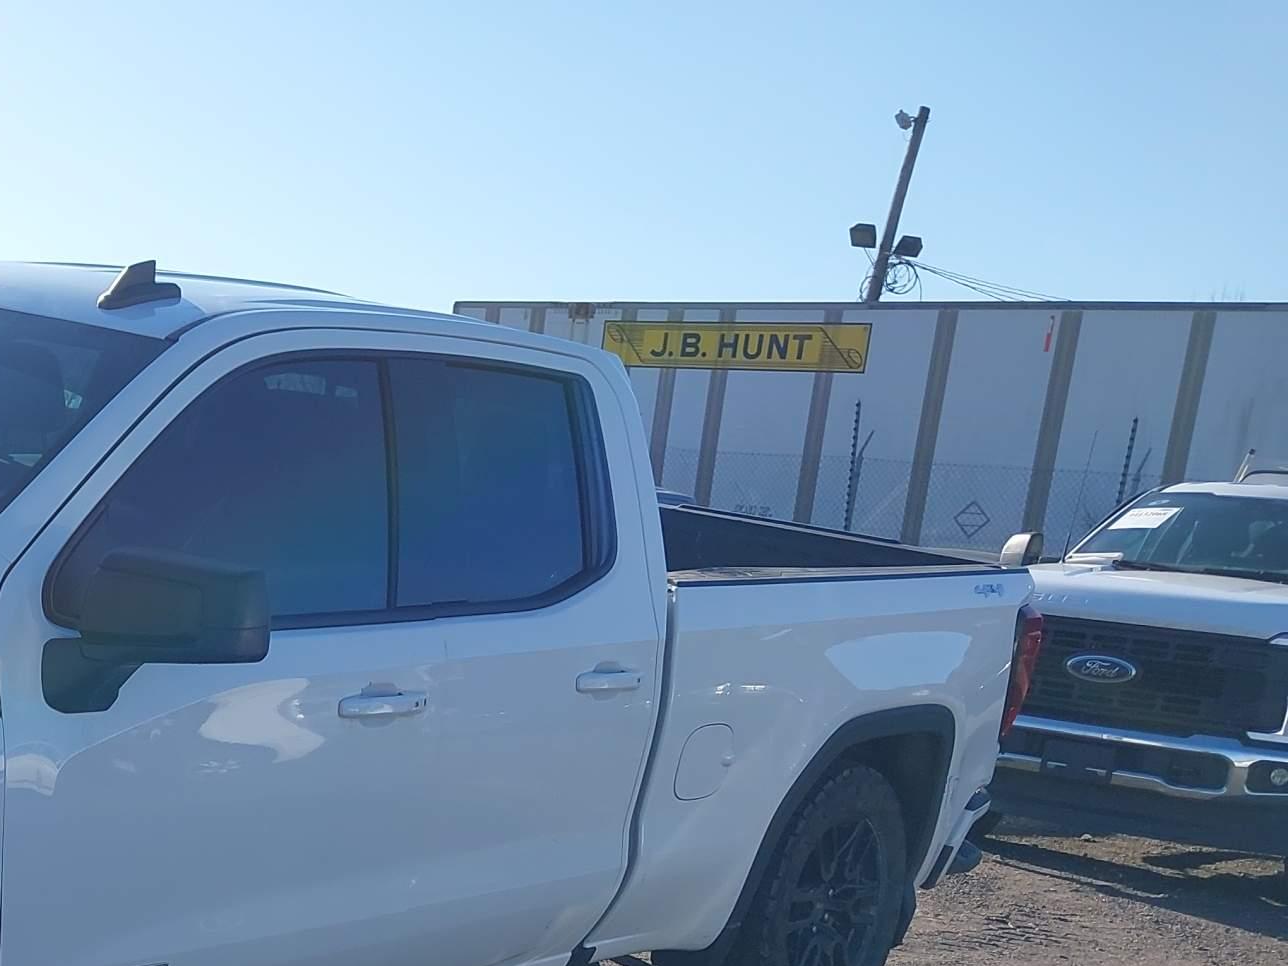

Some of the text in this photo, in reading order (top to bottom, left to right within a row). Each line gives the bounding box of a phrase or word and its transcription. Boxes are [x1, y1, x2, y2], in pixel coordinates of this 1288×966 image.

[649, 332, 813, 360] J.B. HUNT
[1080, 660, 1120, 678] Ford
